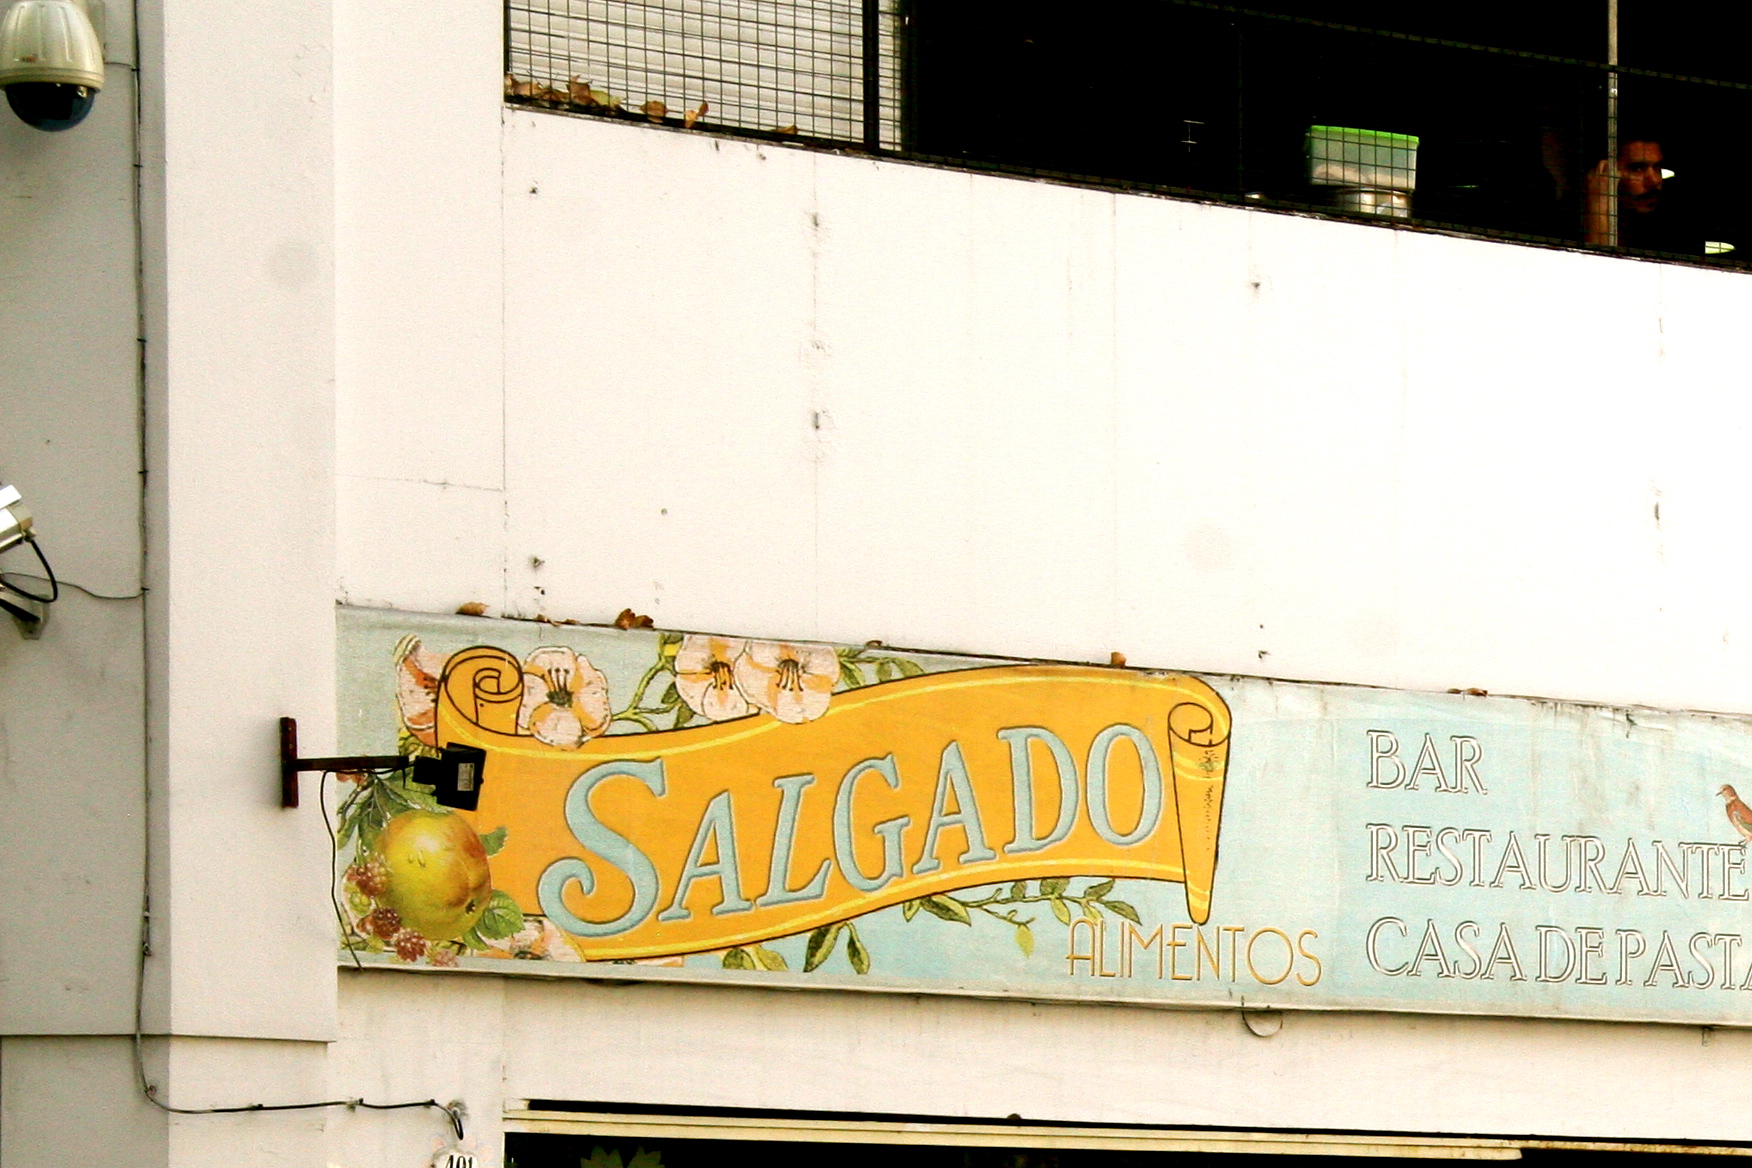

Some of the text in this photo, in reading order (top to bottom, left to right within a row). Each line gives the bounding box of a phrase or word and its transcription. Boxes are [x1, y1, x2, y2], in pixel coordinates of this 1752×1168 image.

[1366, 729, 1488, 795] BAR
[537, 724, 1163, 937] SALGADO
[1365, 823, 1750, 902] RESTAURANTE
[1065, 917, 1322, 986] ALIMENTOS
[1366, 916, 1530, 982] CASA
[1535, 925, 1608, 985] DE
